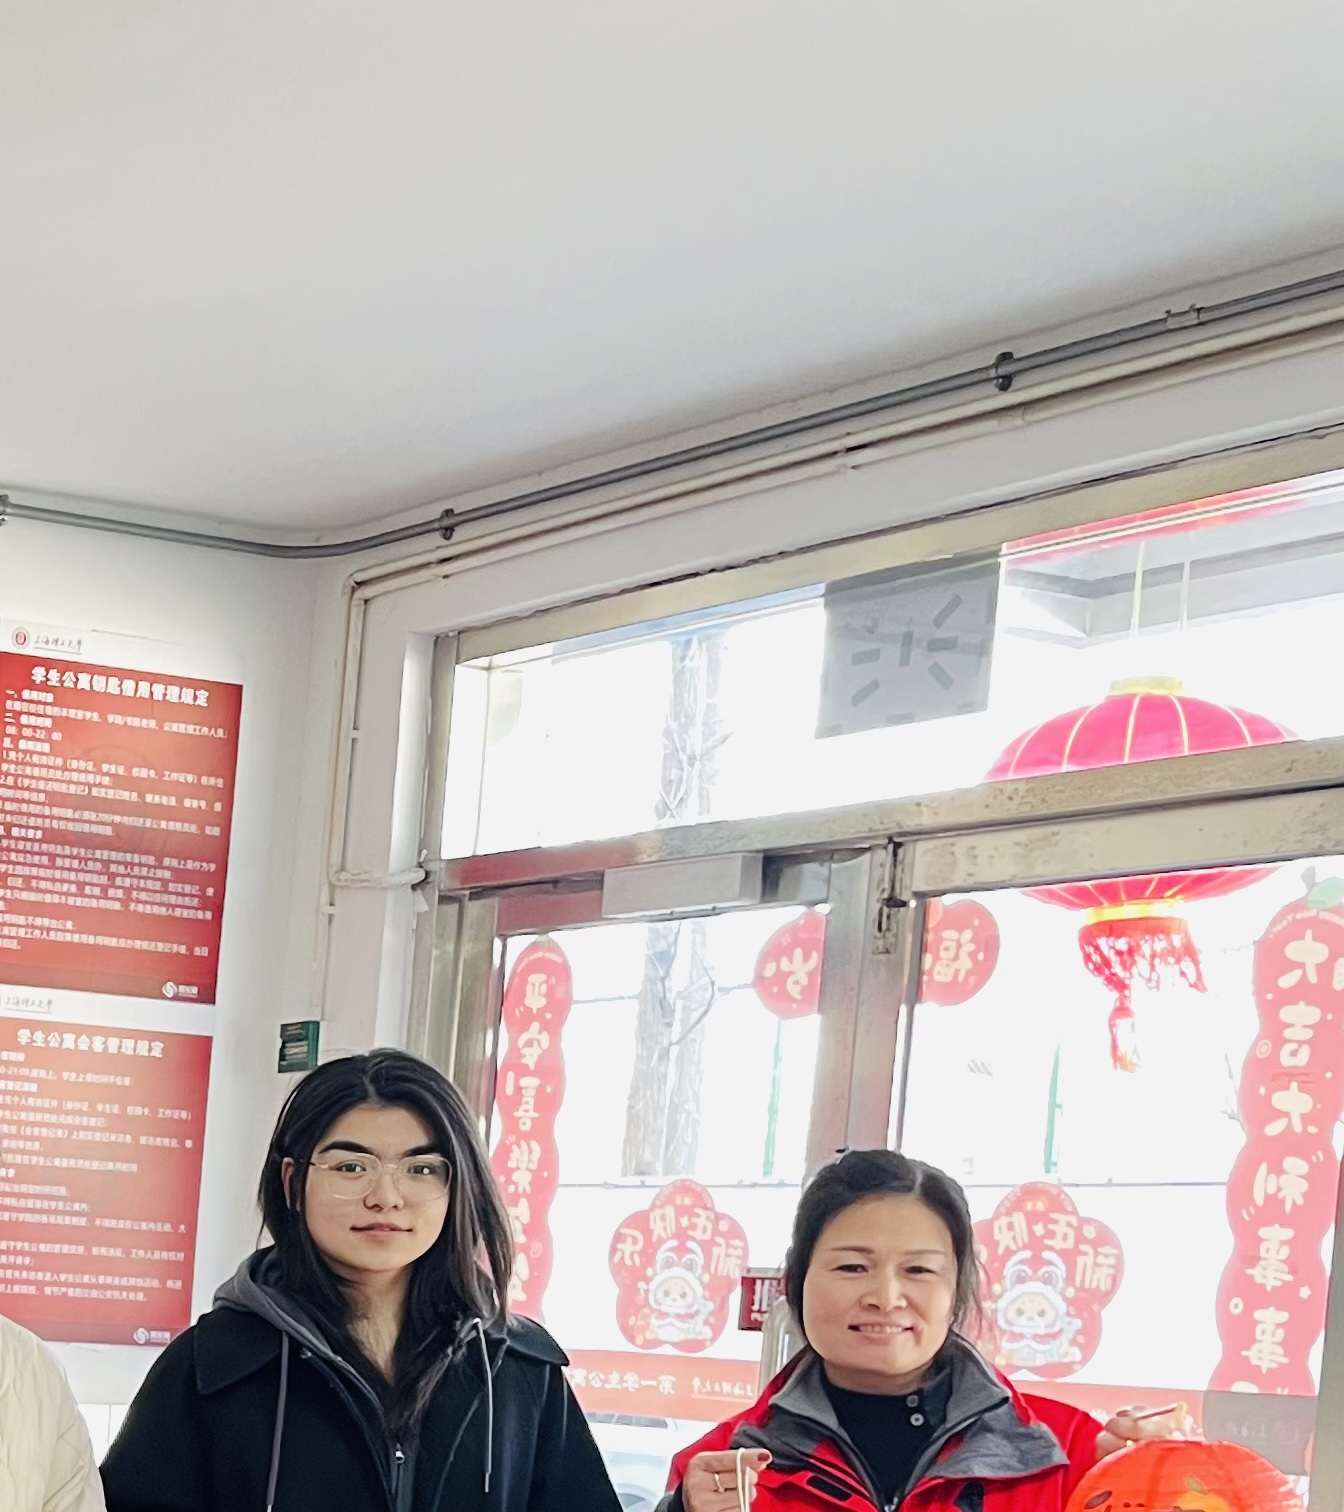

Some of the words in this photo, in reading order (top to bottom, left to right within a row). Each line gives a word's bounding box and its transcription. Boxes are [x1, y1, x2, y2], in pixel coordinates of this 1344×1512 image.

[31, 666, 209, 707] 学生公寓钥匙借用管理规定
[16, 1029, 165, 1059] 学生公寓会客管理规定
